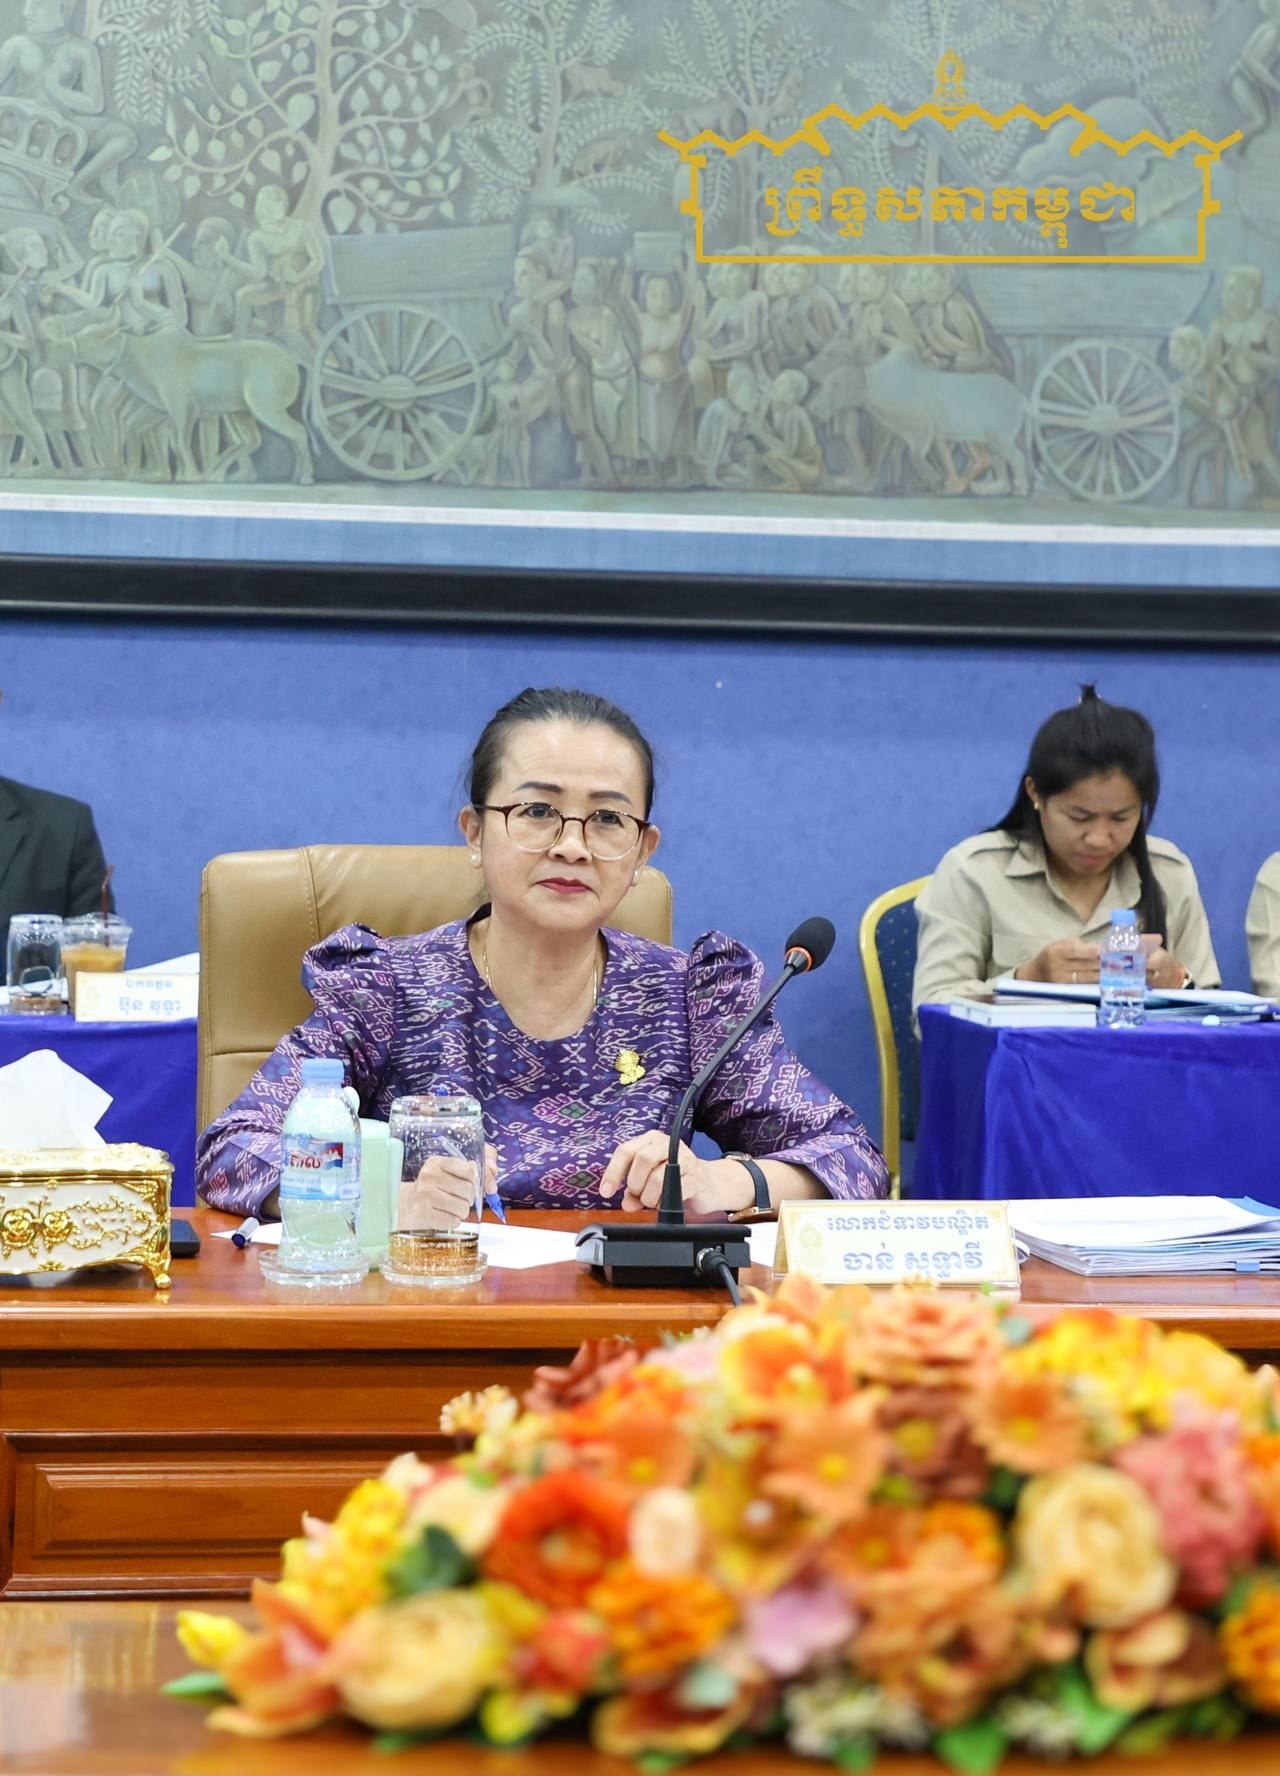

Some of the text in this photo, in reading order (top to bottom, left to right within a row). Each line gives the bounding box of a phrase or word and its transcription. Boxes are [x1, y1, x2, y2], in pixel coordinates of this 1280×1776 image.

[827, 1209, 989, 1236] លោកជំទាវបណ្ឌិត
[843, 1242, 894, 1271] ចាន់
